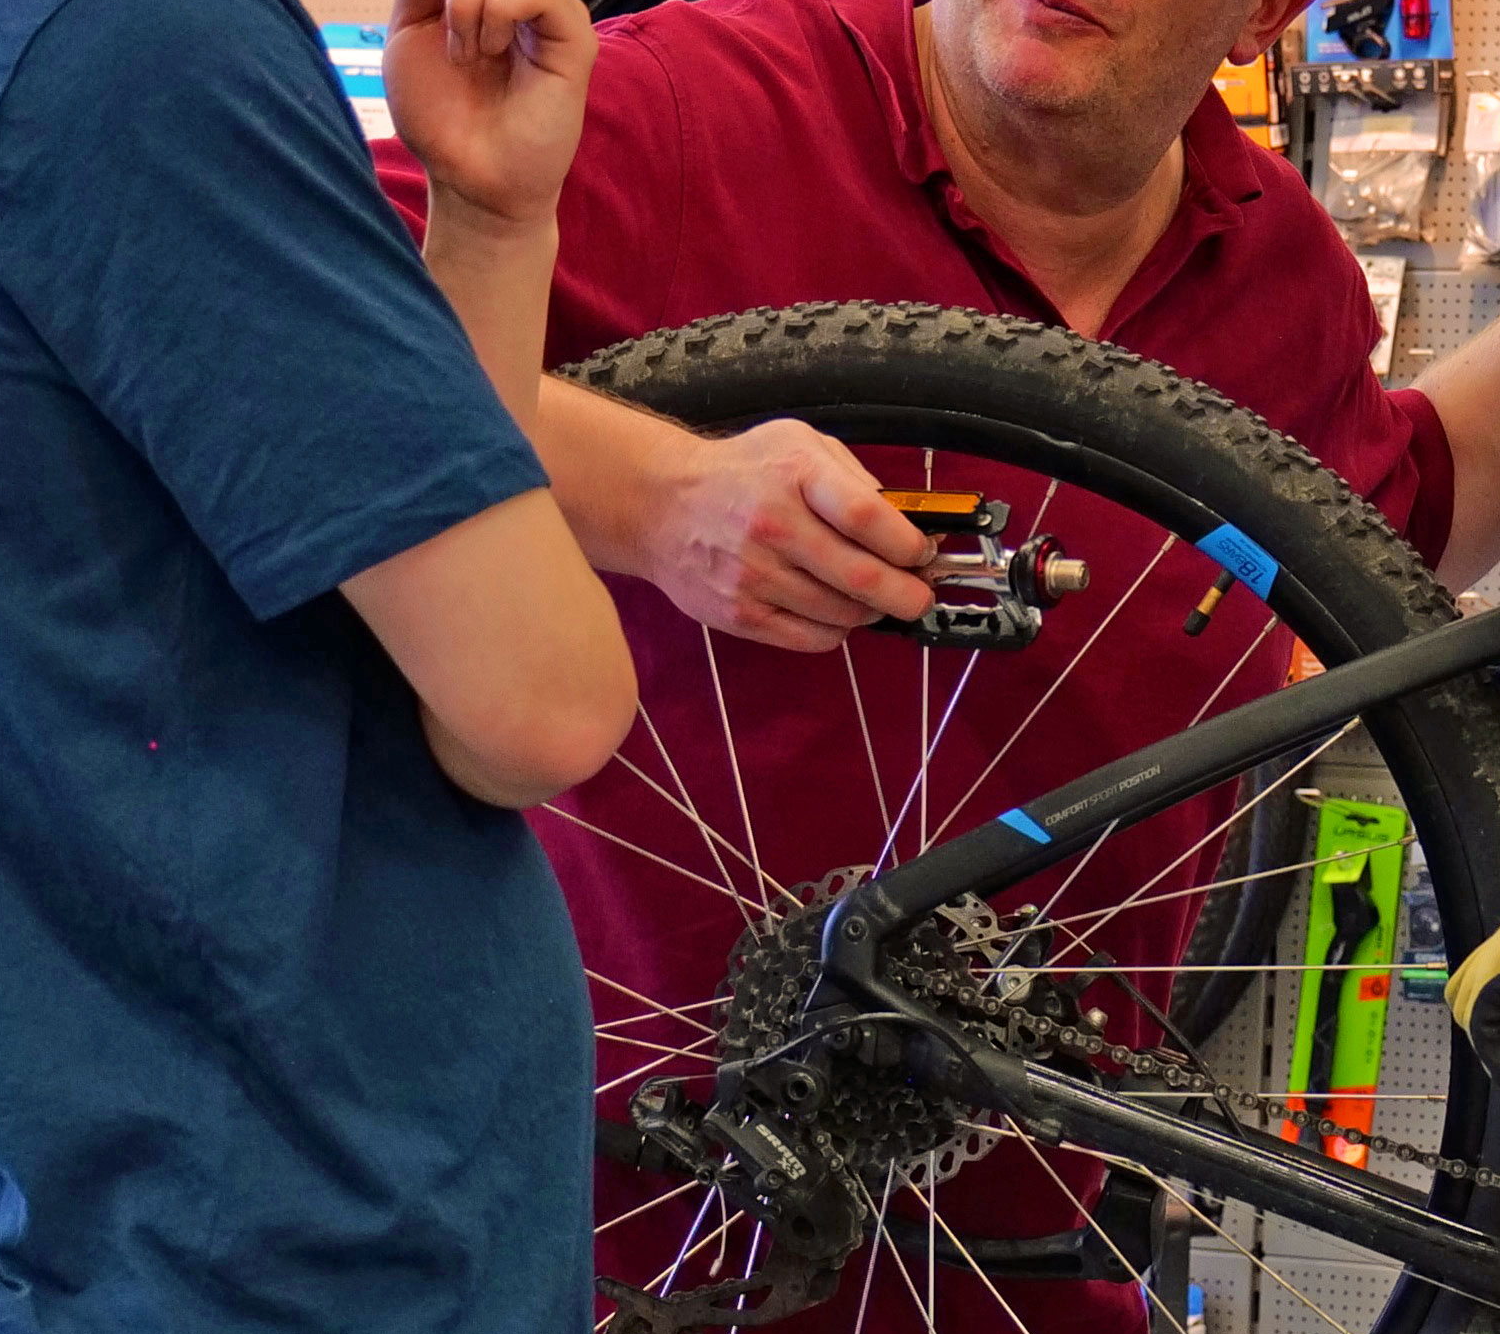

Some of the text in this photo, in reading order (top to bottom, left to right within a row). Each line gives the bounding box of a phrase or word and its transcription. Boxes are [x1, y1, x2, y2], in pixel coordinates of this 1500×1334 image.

[1045, 764, 1161, 827] COMFORT SPORT POSITION
[755, 1123, 807, 1176] SRAM
